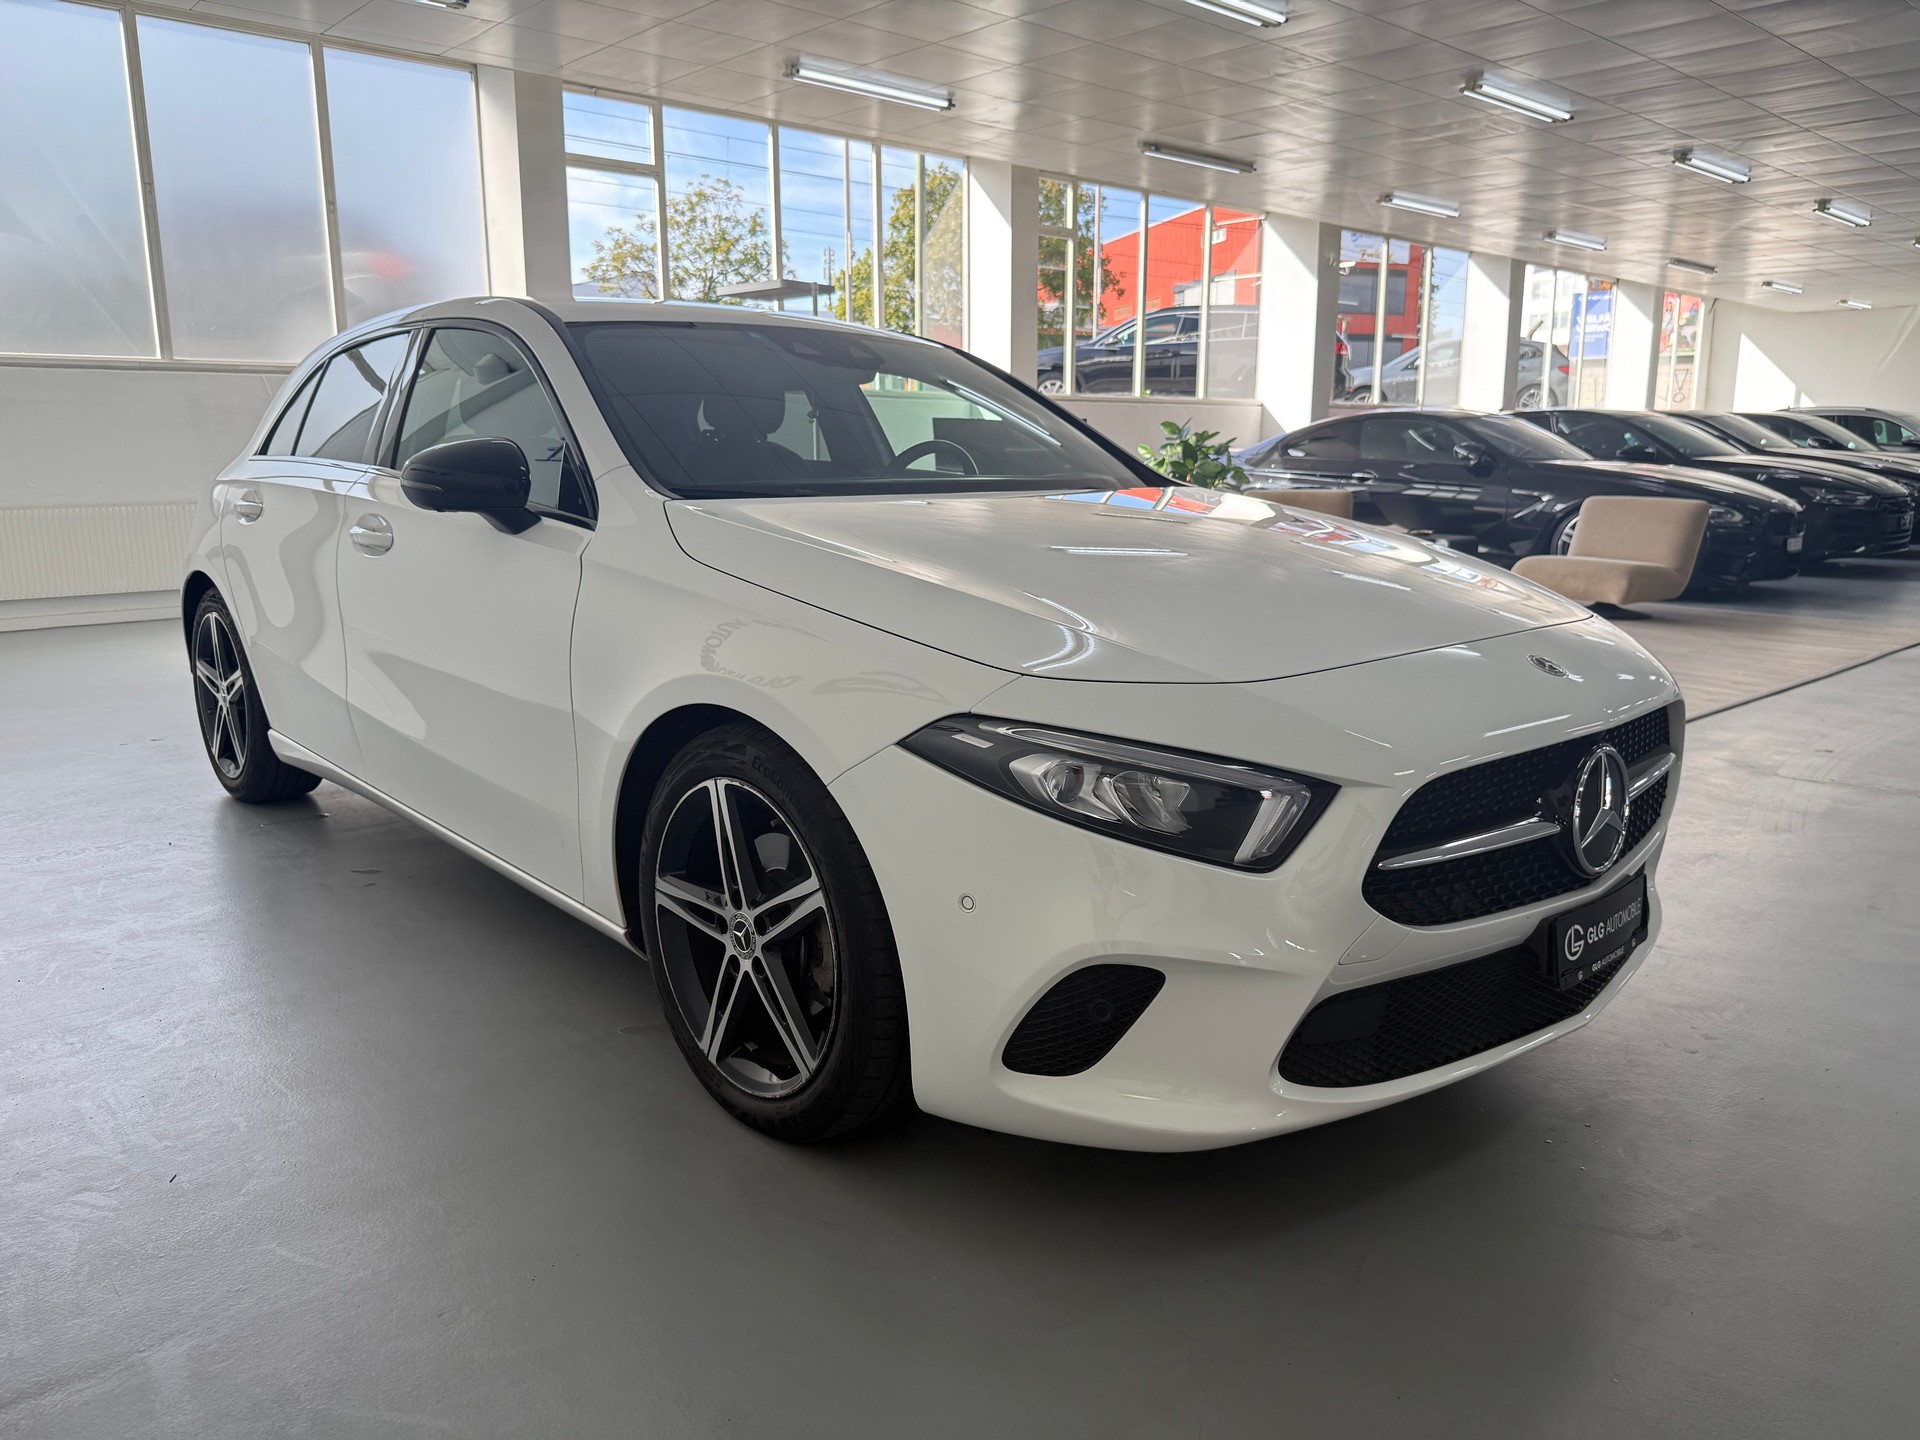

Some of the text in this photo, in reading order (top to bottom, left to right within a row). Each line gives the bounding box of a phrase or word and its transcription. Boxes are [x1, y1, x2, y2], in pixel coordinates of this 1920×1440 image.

[1587, 897, 1641, 944] GLG AUTOMOBILE
[1592, 960, 1601, 972] GLG
[1602, 945, 1624, 964] AUTOMOBILE
